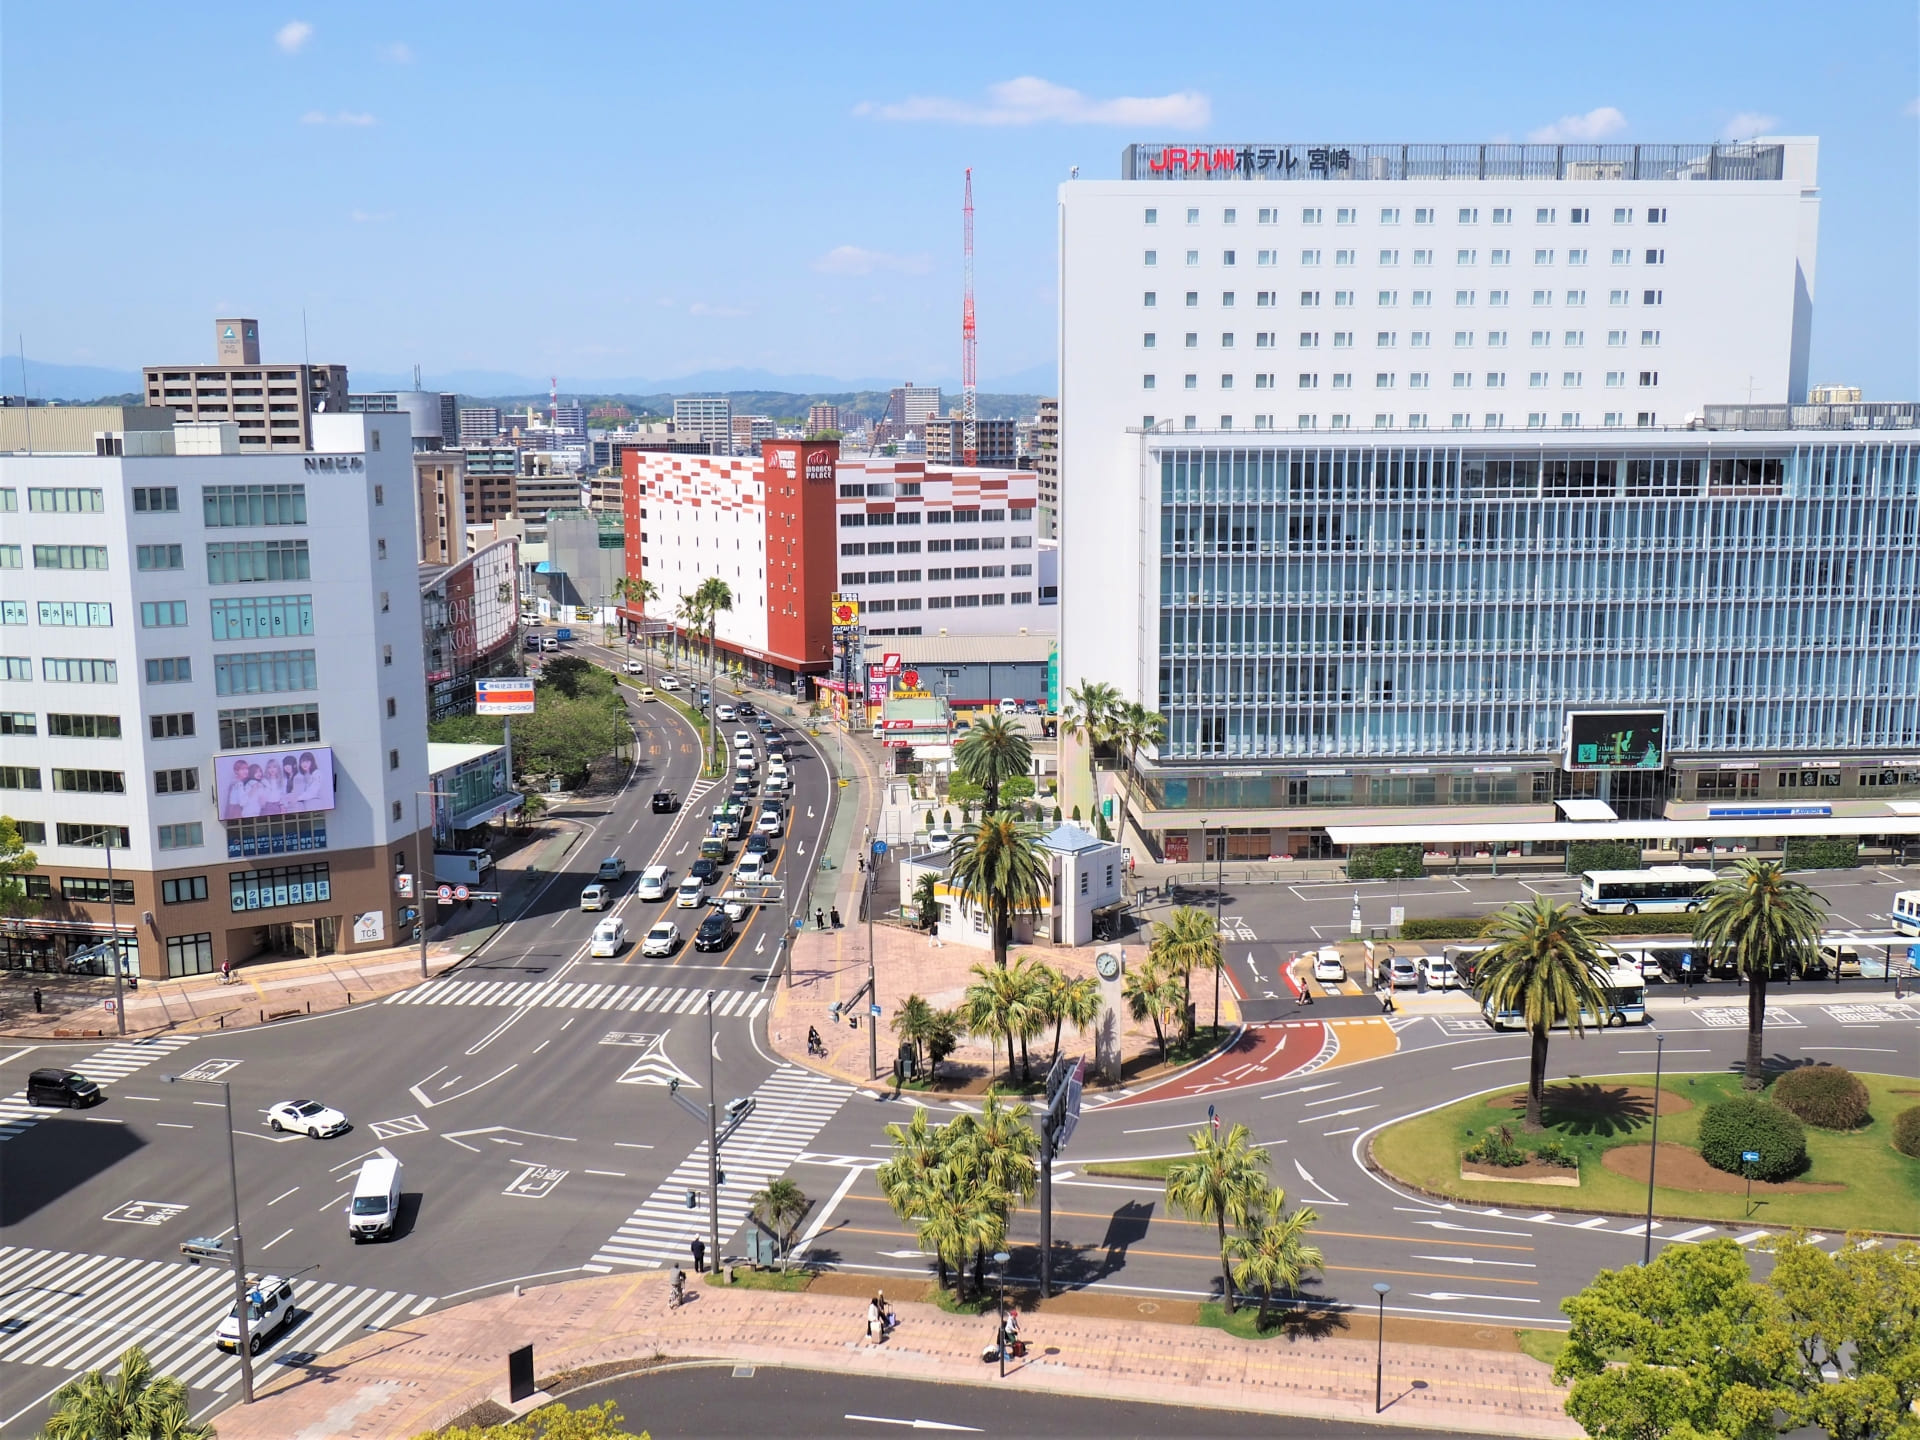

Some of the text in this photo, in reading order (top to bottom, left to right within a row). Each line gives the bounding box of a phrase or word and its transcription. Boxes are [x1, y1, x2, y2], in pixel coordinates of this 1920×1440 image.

[1150, 148, 1350, 170] JR九州ホテル 宮崎
[304, 456, 363, 470] NMビル
[246, 616, 281, 627] TCB
[361, 929, 378, 938] TCB
